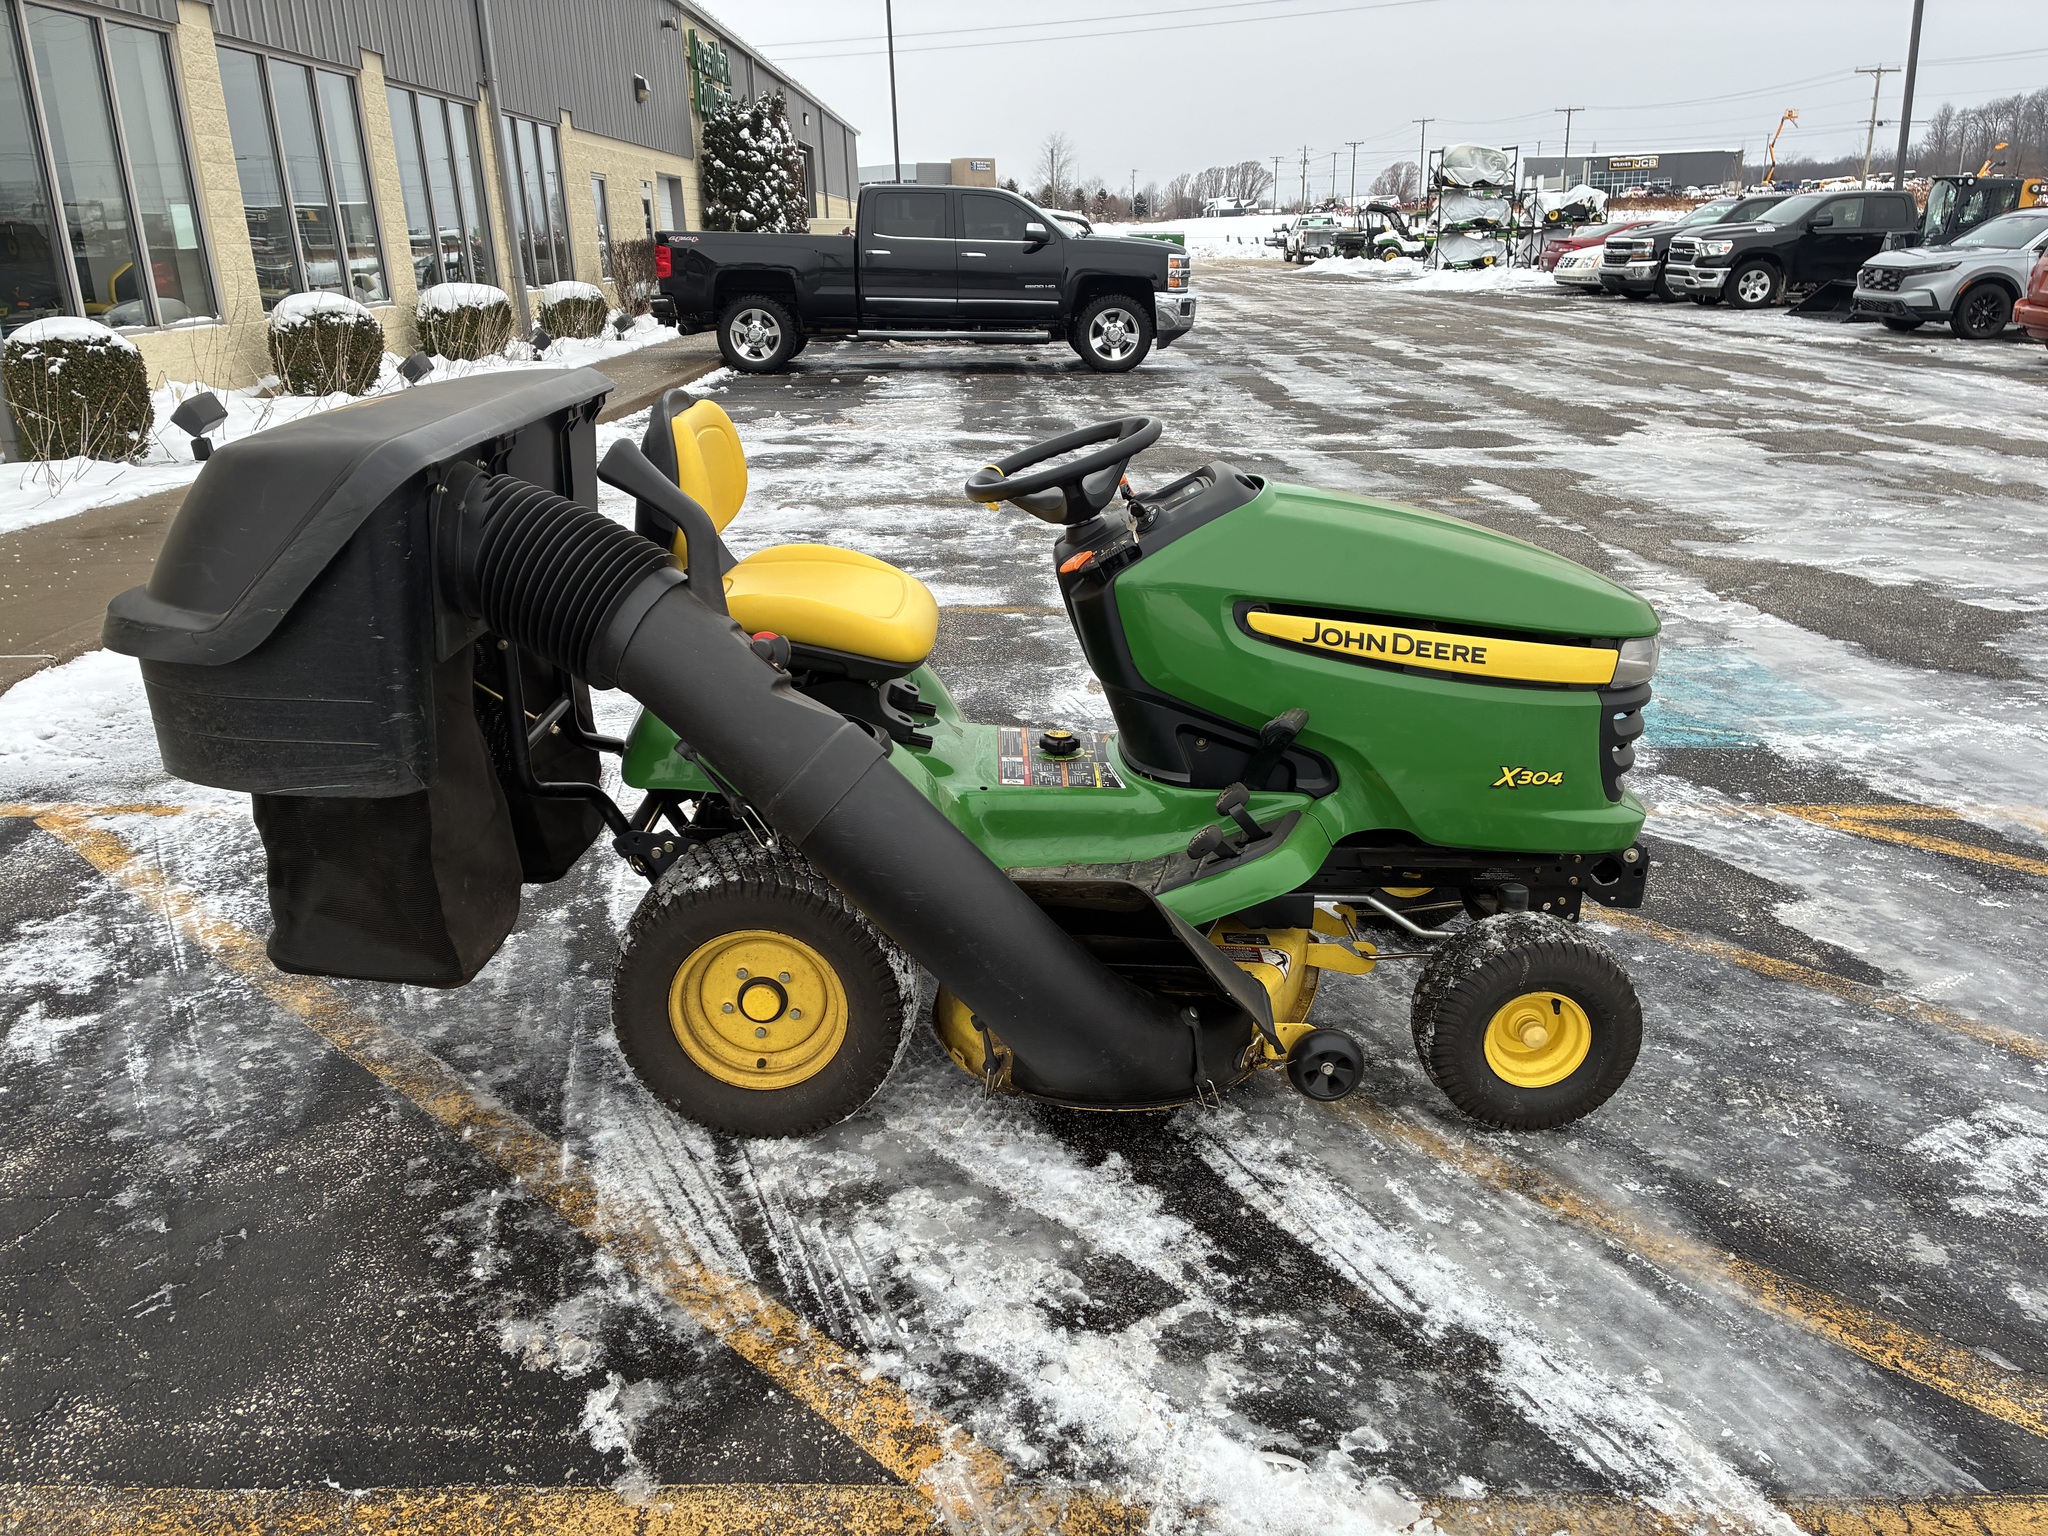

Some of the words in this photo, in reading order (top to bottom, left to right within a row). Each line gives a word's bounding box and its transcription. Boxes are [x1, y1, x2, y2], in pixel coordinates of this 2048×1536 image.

[1634, 158, 1657, 168] JCB
[1302, 622, 1387, 653] JOHN
[1392, 632, 1487, 664] DEERE
[1489, 765, 1564, 789] X304
